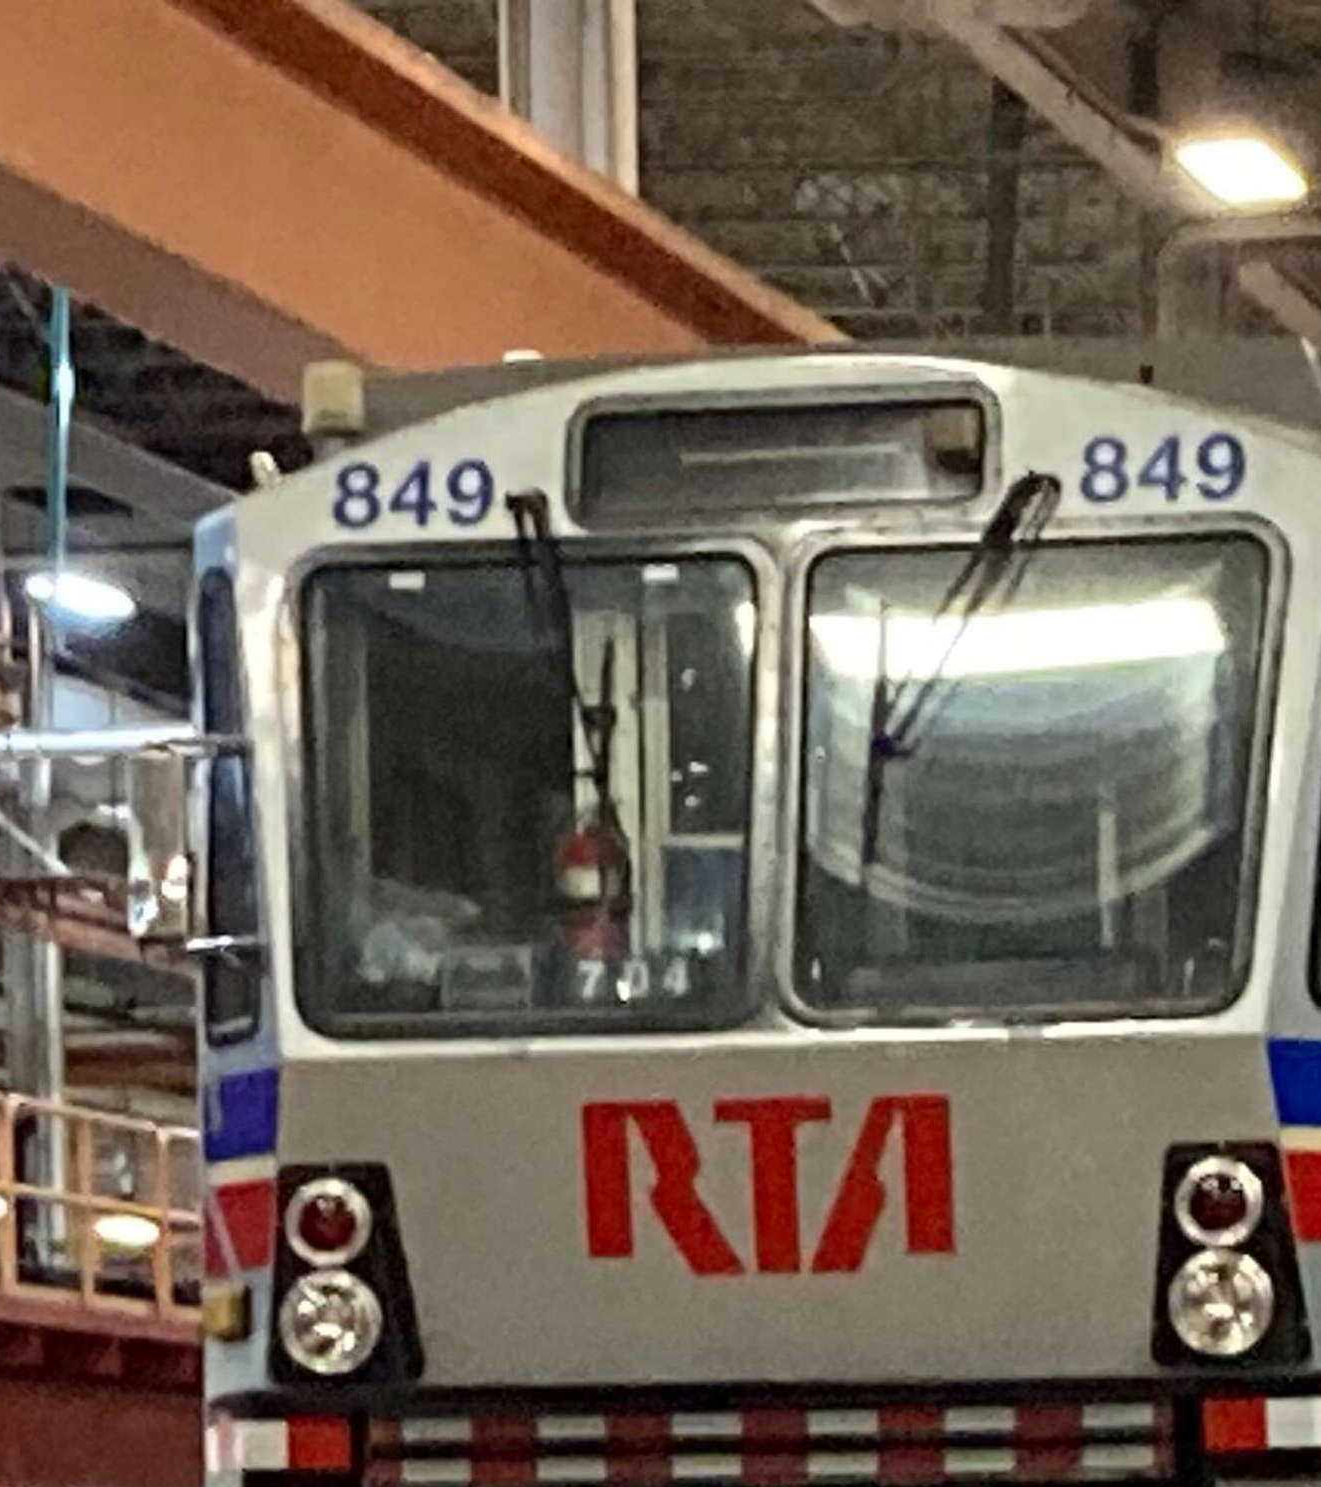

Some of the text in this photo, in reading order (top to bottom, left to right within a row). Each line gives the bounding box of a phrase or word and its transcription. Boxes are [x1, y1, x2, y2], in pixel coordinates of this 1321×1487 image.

[334, 457, 494, 528] 849
[1080, 432, 1245, 503] 849
[577, 957, 690, 1000] 704
[583, 1094, 955, 1276] RTA
